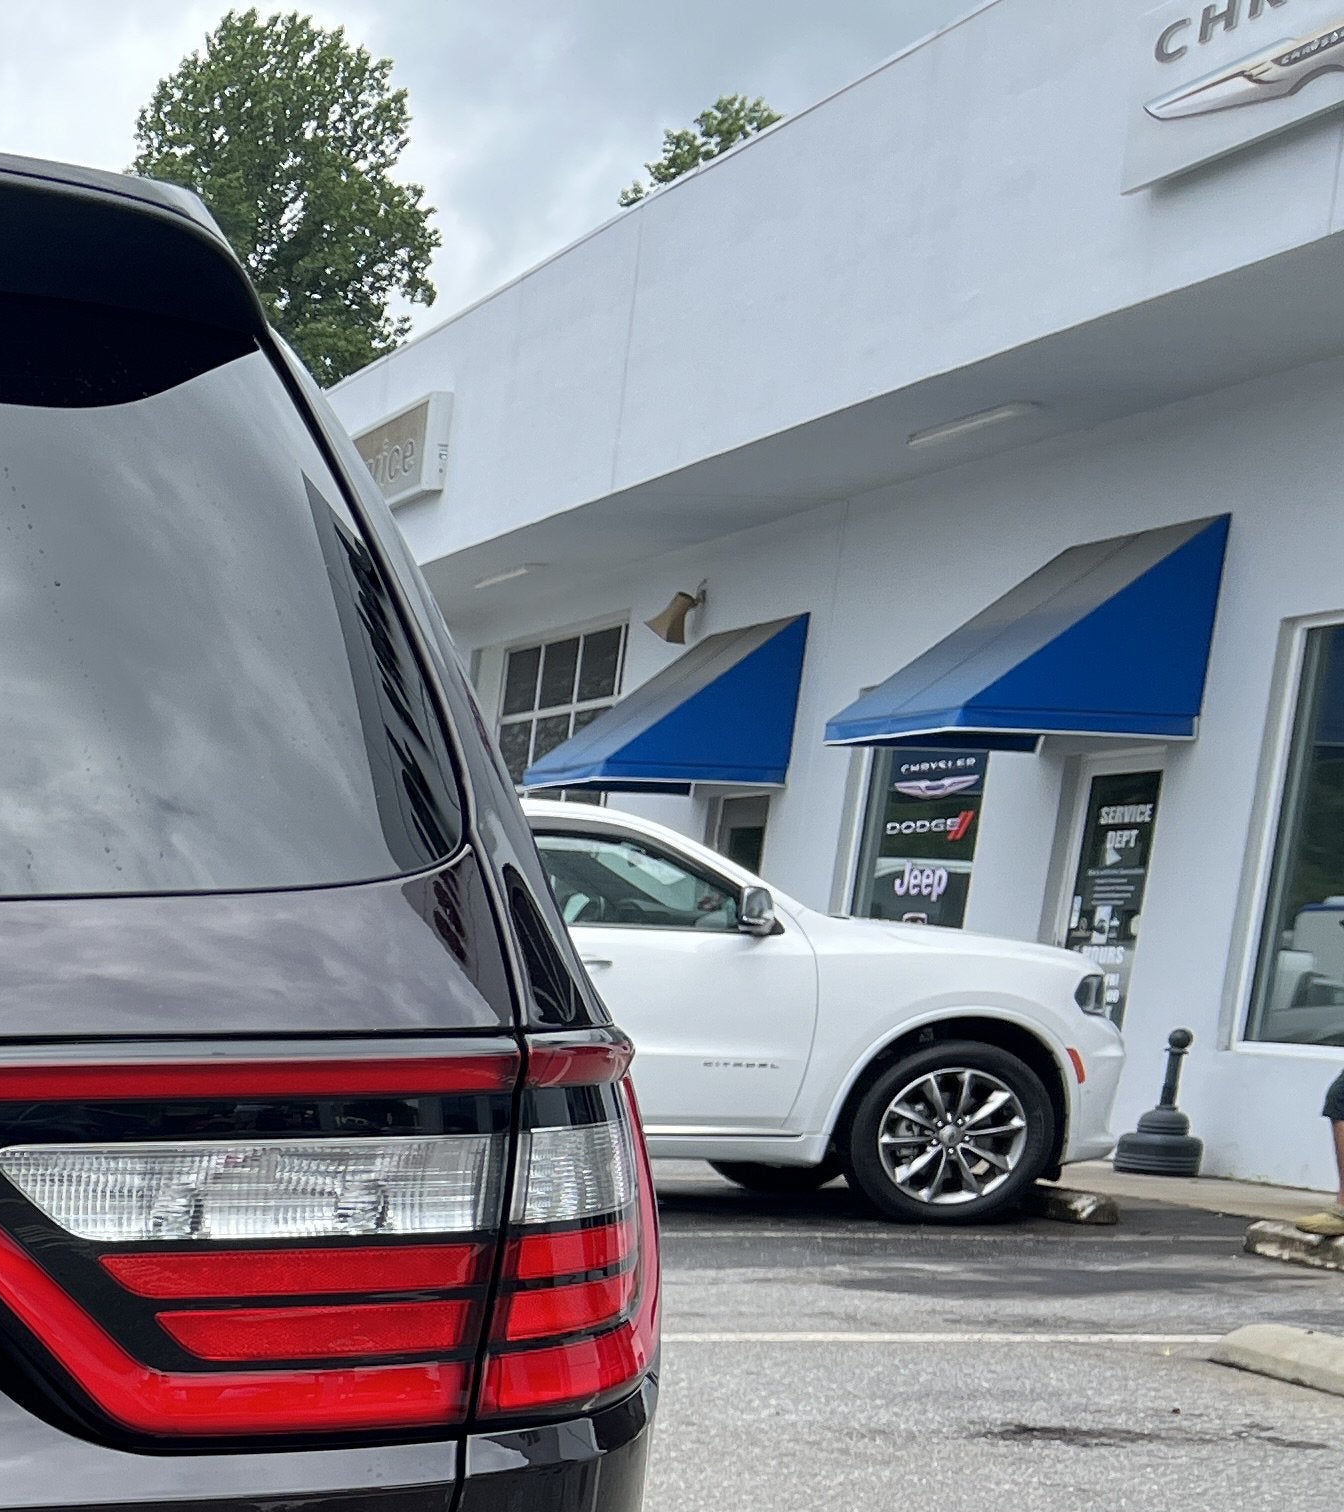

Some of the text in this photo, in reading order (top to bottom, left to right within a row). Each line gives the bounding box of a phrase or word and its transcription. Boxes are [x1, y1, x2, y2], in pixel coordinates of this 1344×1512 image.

[365, 438, 416, 486] vice
[1099, 803, 1155, 826] SERVICE
[885, 817, 961, 836] DODGE
[1107, 829, 1140, 849] DEPT
[894, 861, 948, 902] Jeep
